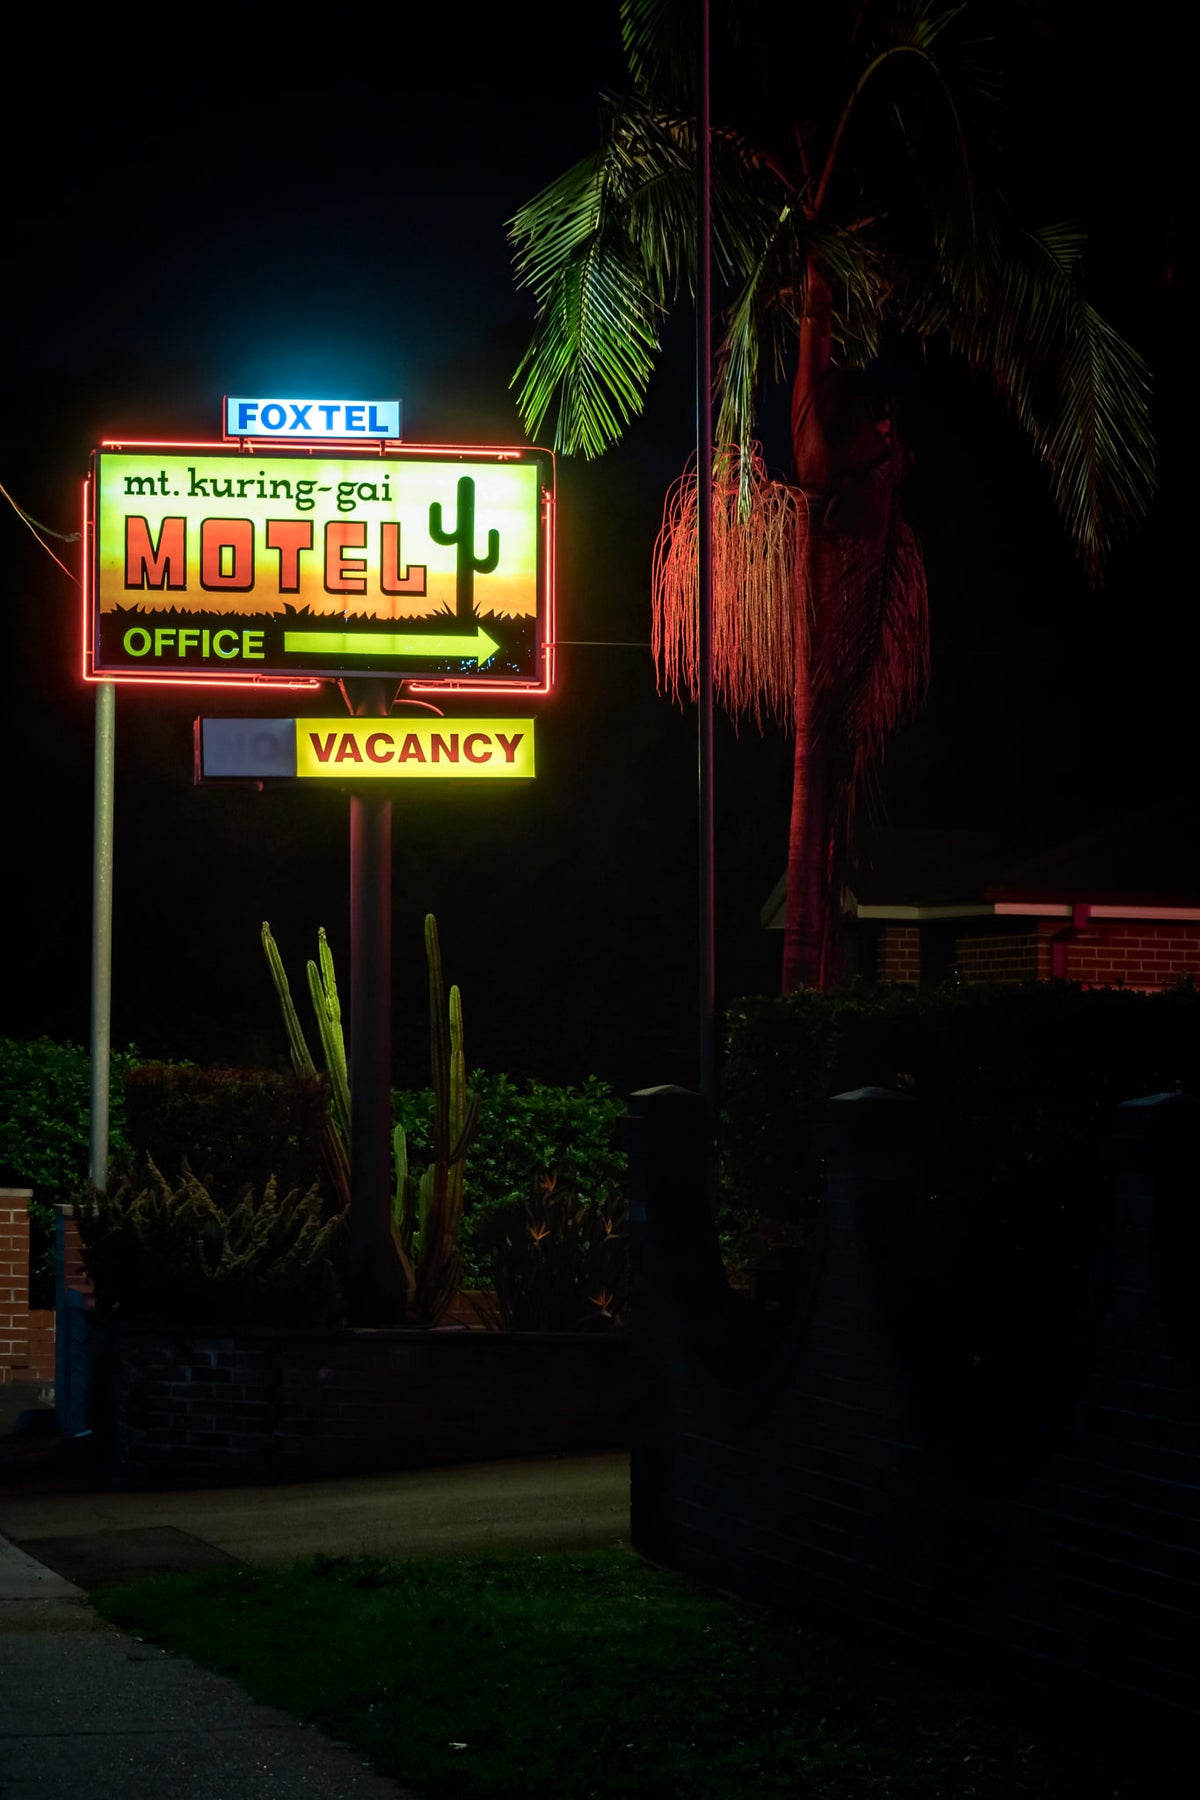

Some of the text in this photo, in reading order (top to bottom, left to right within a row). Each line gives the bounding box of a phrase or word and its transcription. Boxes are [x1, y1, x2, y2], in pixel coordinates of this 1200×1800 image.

[238, 403, 389, 432] FOXTEL
[124, 468, 392, 512] mt. kuring-gai
[124, 515, 427, 597] MOTEL
[123, 628, 265, 659] OFFICE
[309, 732, 525, 763] VACANCY
